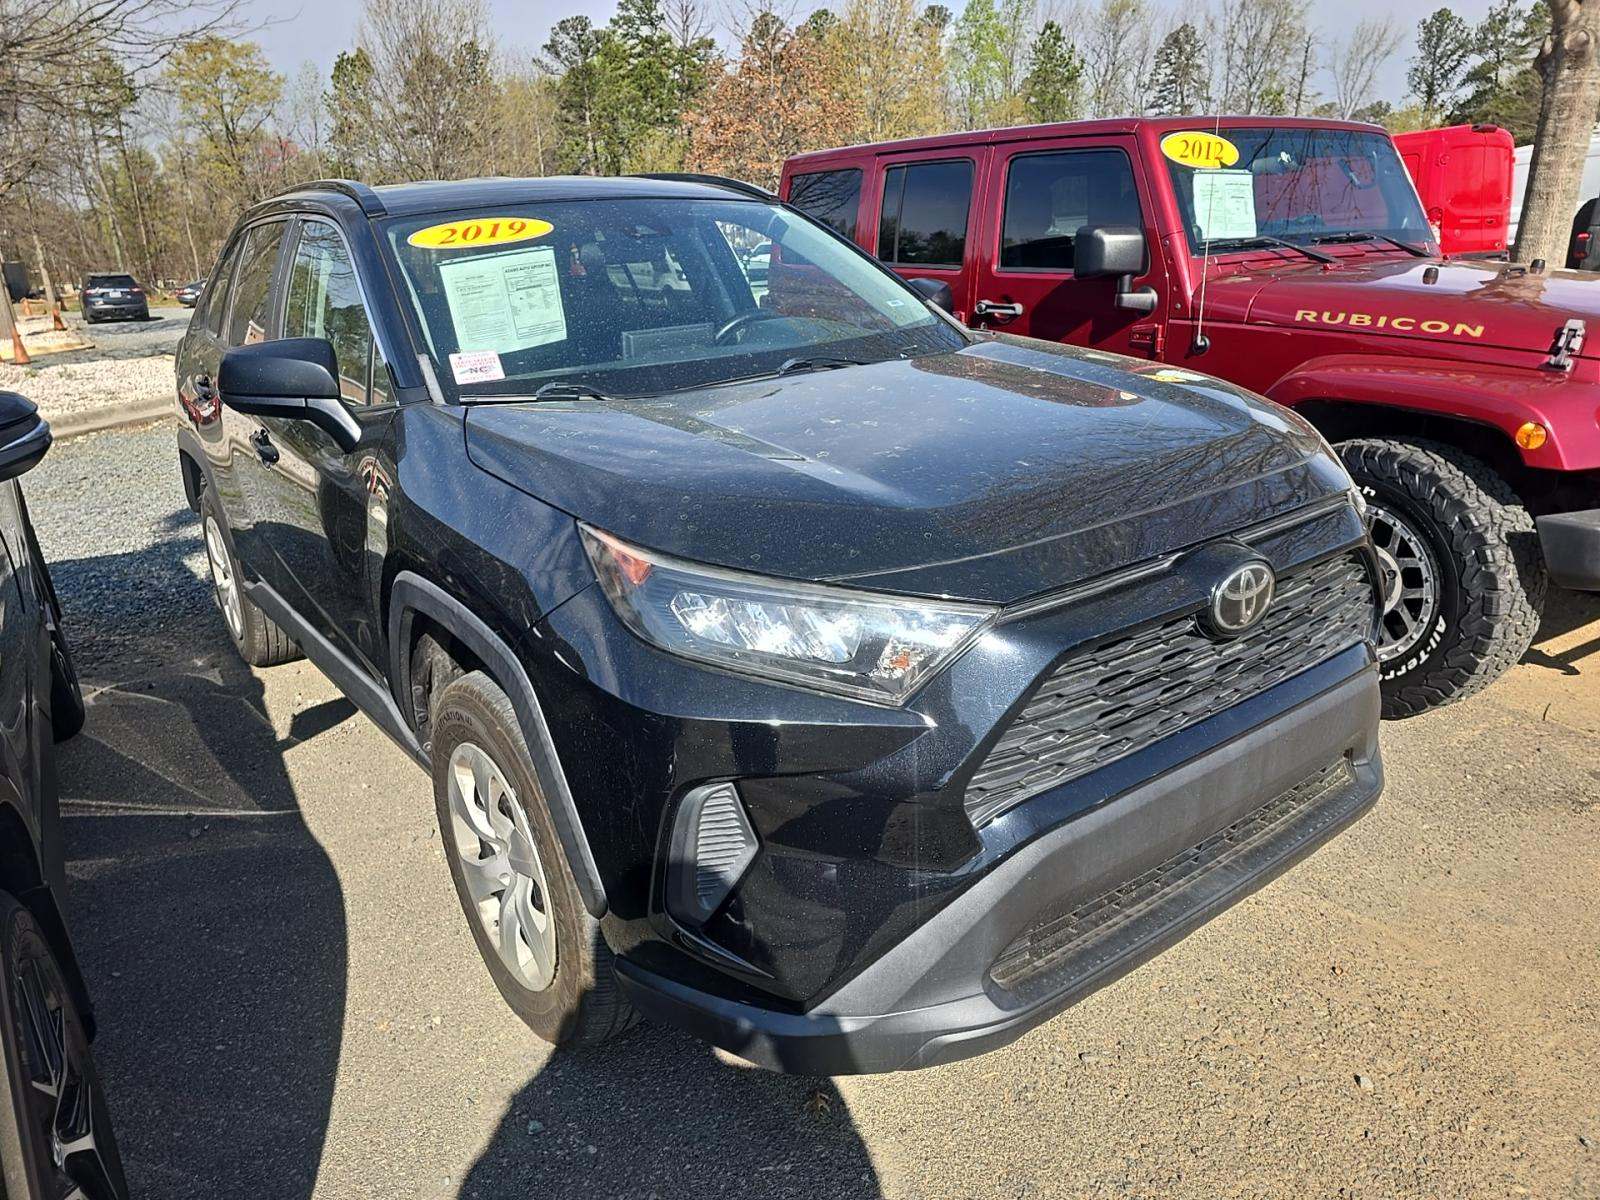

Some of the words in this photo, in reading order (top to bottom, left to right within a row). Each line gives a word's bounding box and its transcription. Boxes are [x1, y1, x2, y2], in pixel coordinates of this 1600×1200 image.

[1179, 139, 1224, 161] 2012
[438, 221, 527, 245] 2019
[1294, 309, 1485, 338] RUBICON
